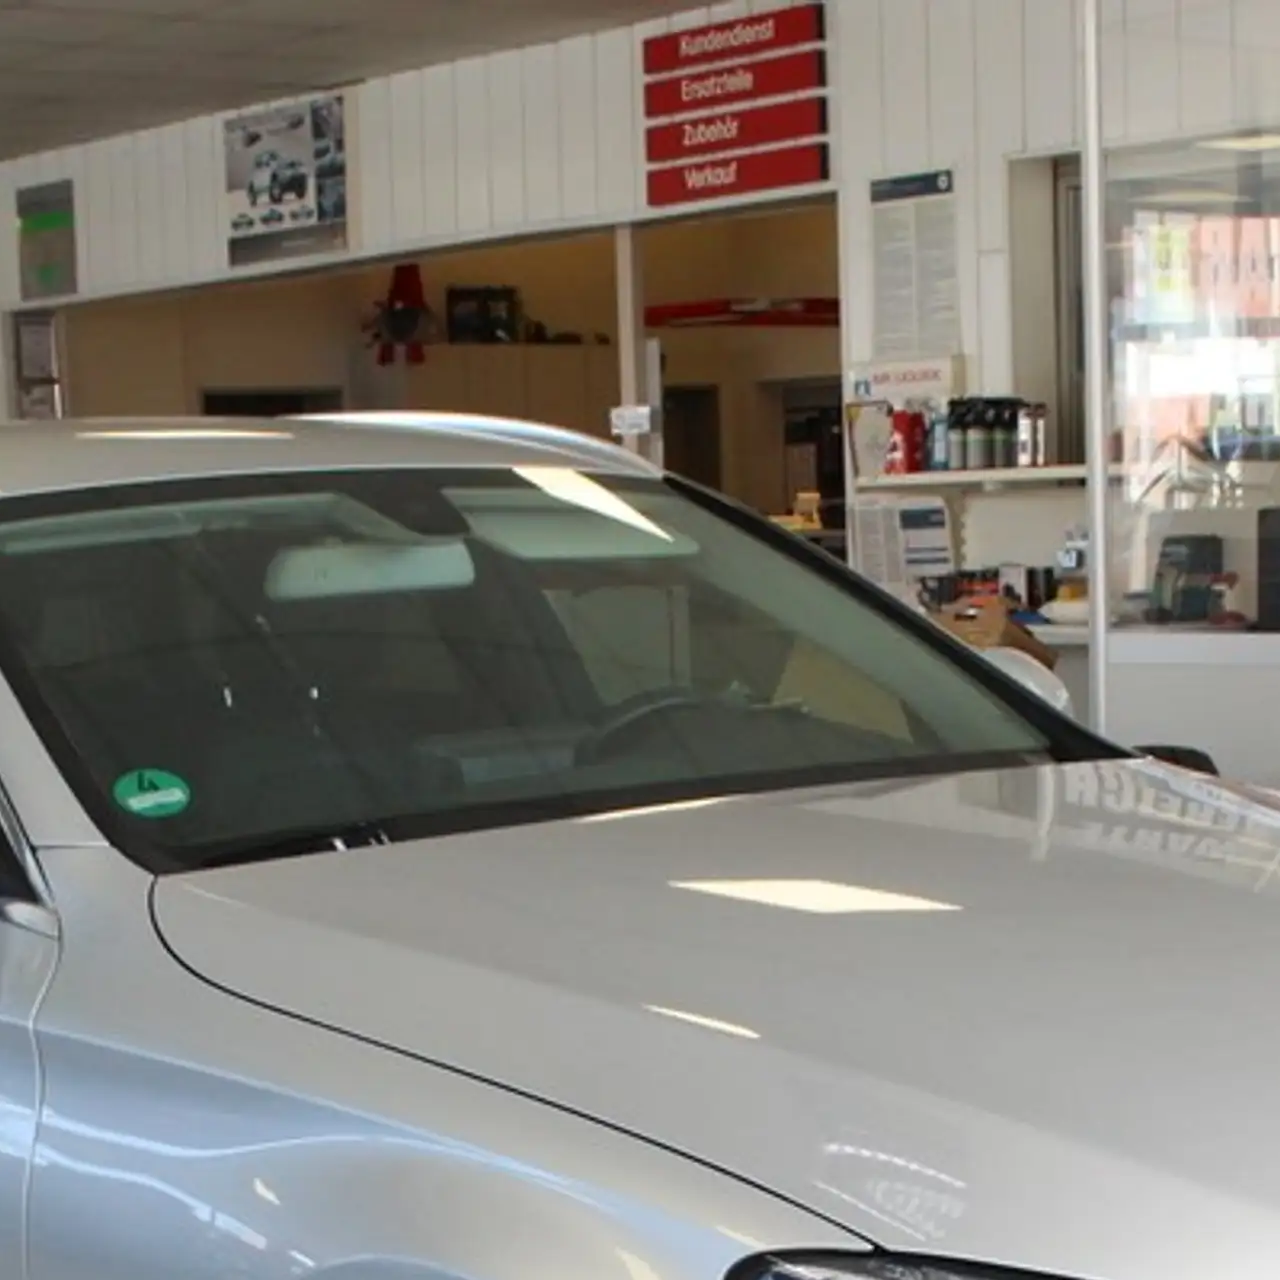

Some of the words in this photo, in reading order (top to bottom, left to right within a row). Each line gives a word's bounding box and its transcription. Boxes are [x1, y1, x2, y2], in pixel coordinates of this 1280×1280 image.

[679, 19, 775, 57] Kundendienst
[680, 68, 755, 102] Ersatzteile
[681, 114, 739, 147] Zubehör
[683, 160, 738, 190] Verkauf
